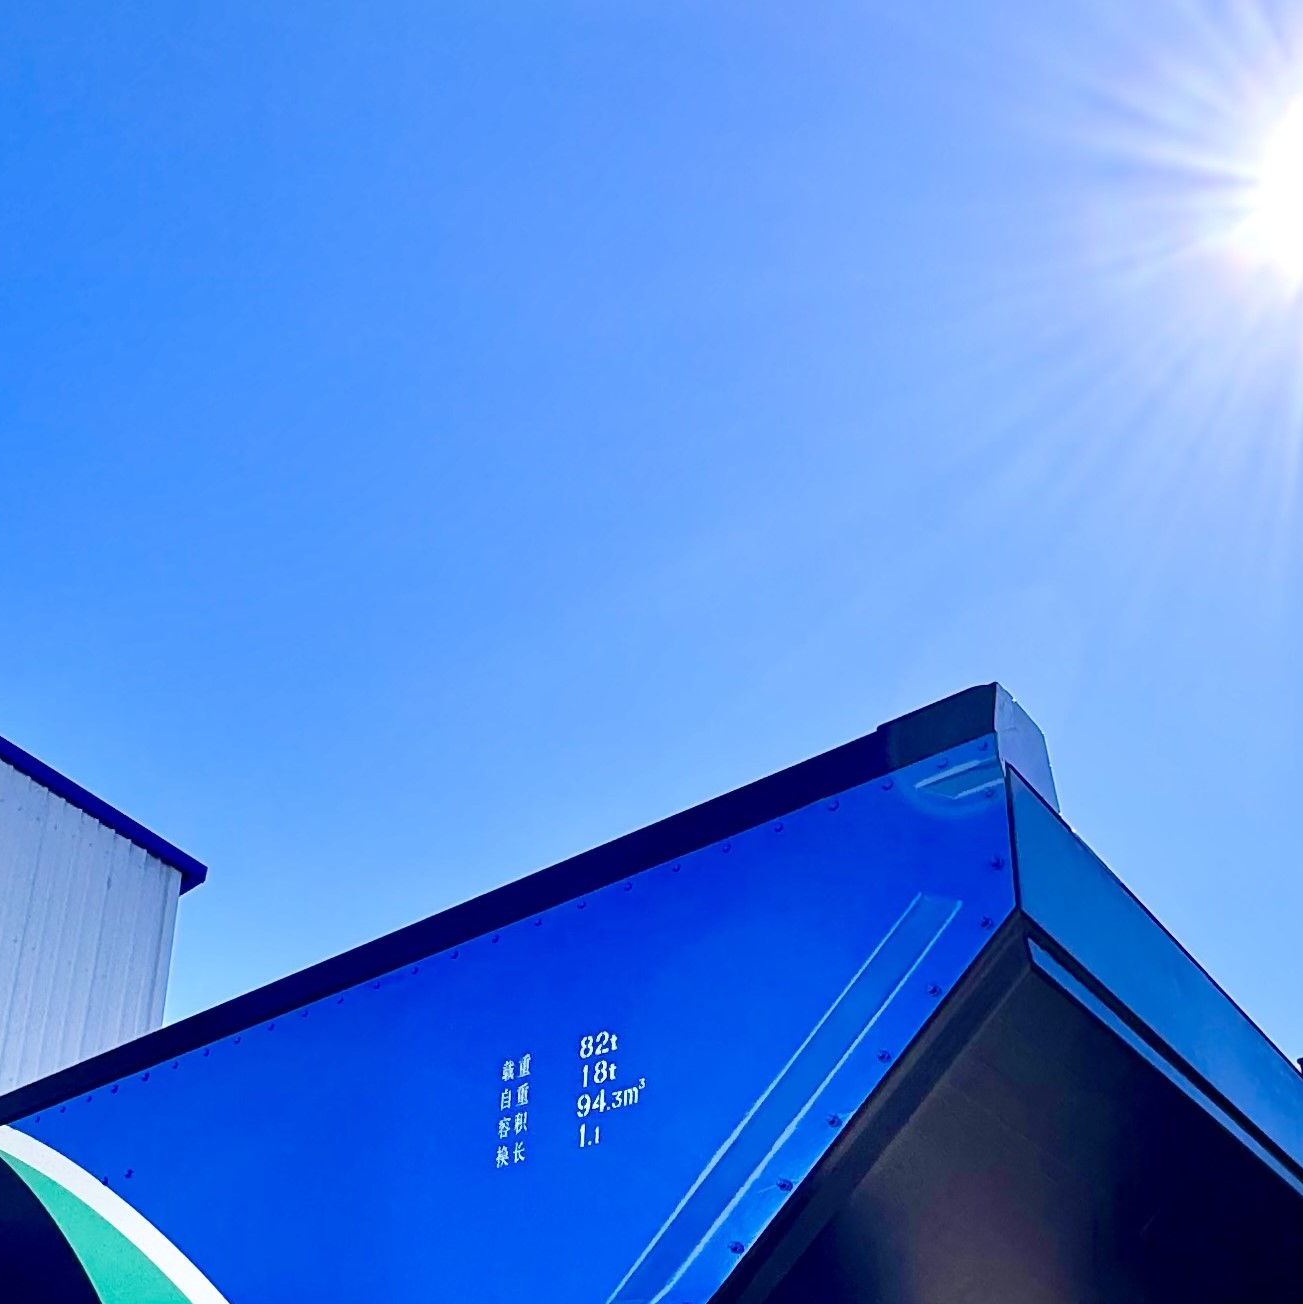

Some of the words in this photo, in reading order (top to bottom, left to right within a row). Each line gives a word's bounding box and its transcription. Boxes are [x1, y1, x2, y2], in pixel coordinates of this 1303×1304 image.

[579, 1031, 618, 1059] 82t
[499, 1083, 530, 1112] 自重
[582, 1060, 617, 1088] 18t
[497, 1111, 528, 1140] 容积
[495, 1142, 526, 1169] 换长
[579, 1123, 601, 1148] 1.1
